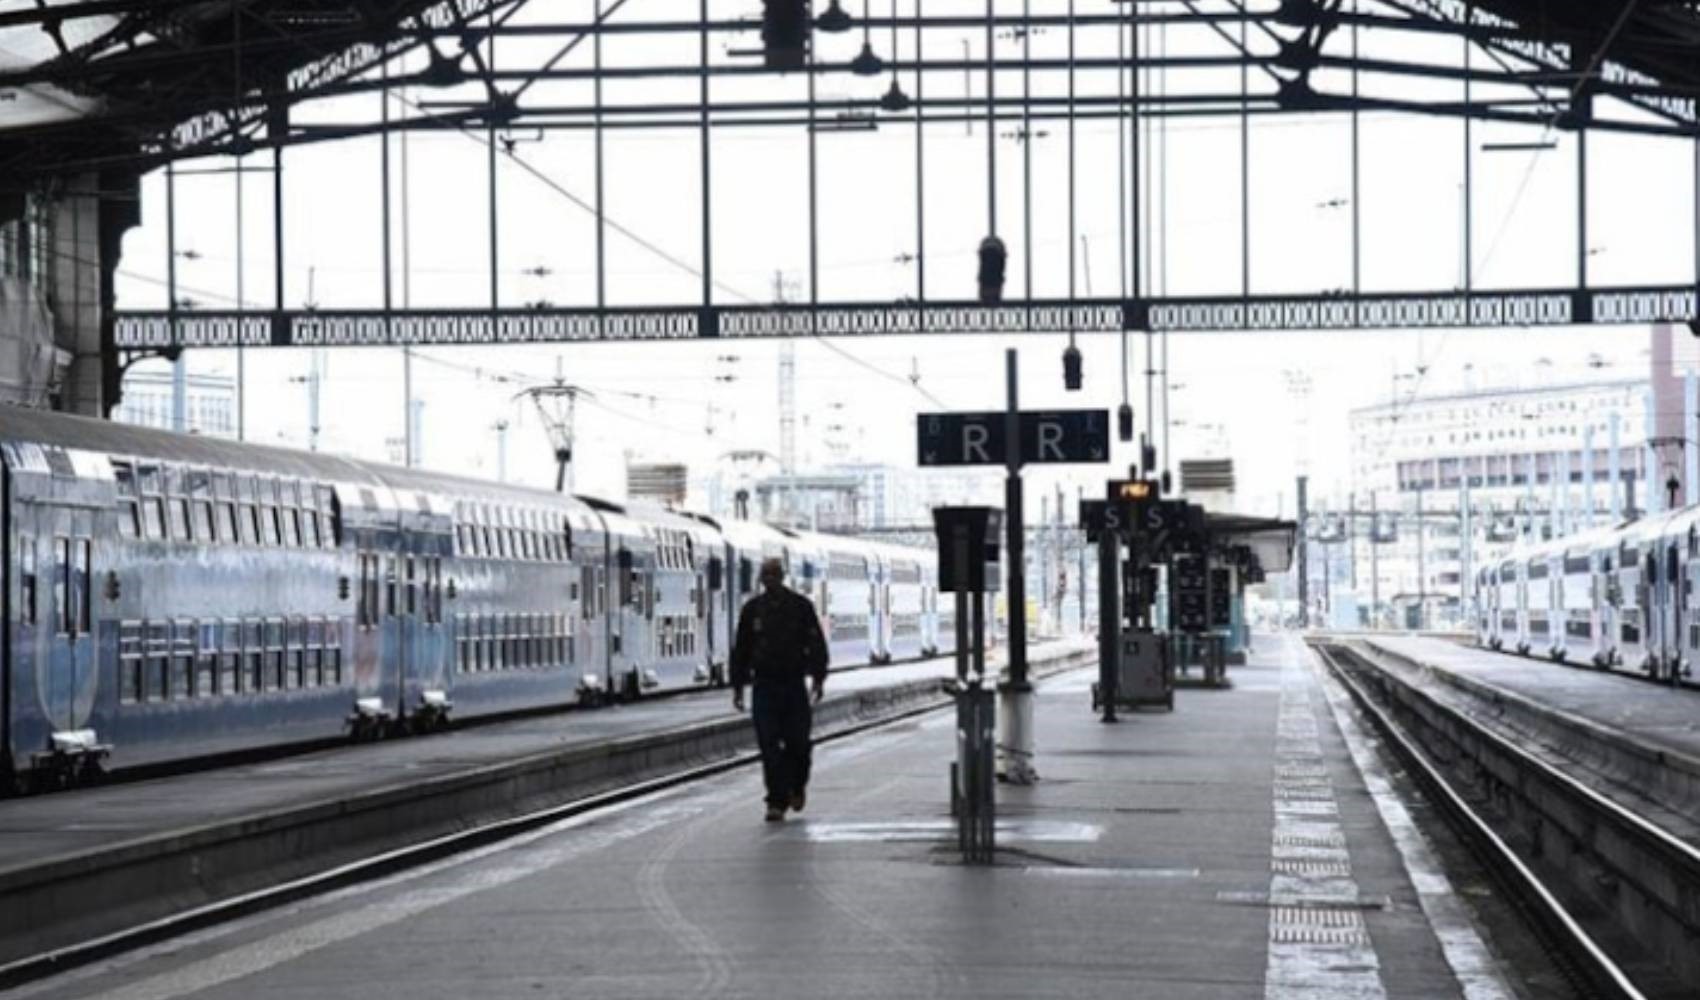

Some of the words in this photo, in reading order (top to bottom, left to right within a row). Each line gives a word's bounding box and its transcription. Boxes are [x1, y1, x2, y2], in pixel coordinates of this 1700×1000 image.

[962, 423, 990, 462] R
[1037, 421, 1066, 459] R
[1104, 506, 1120, 529] S
[1147, 505, 1164, 529] S
